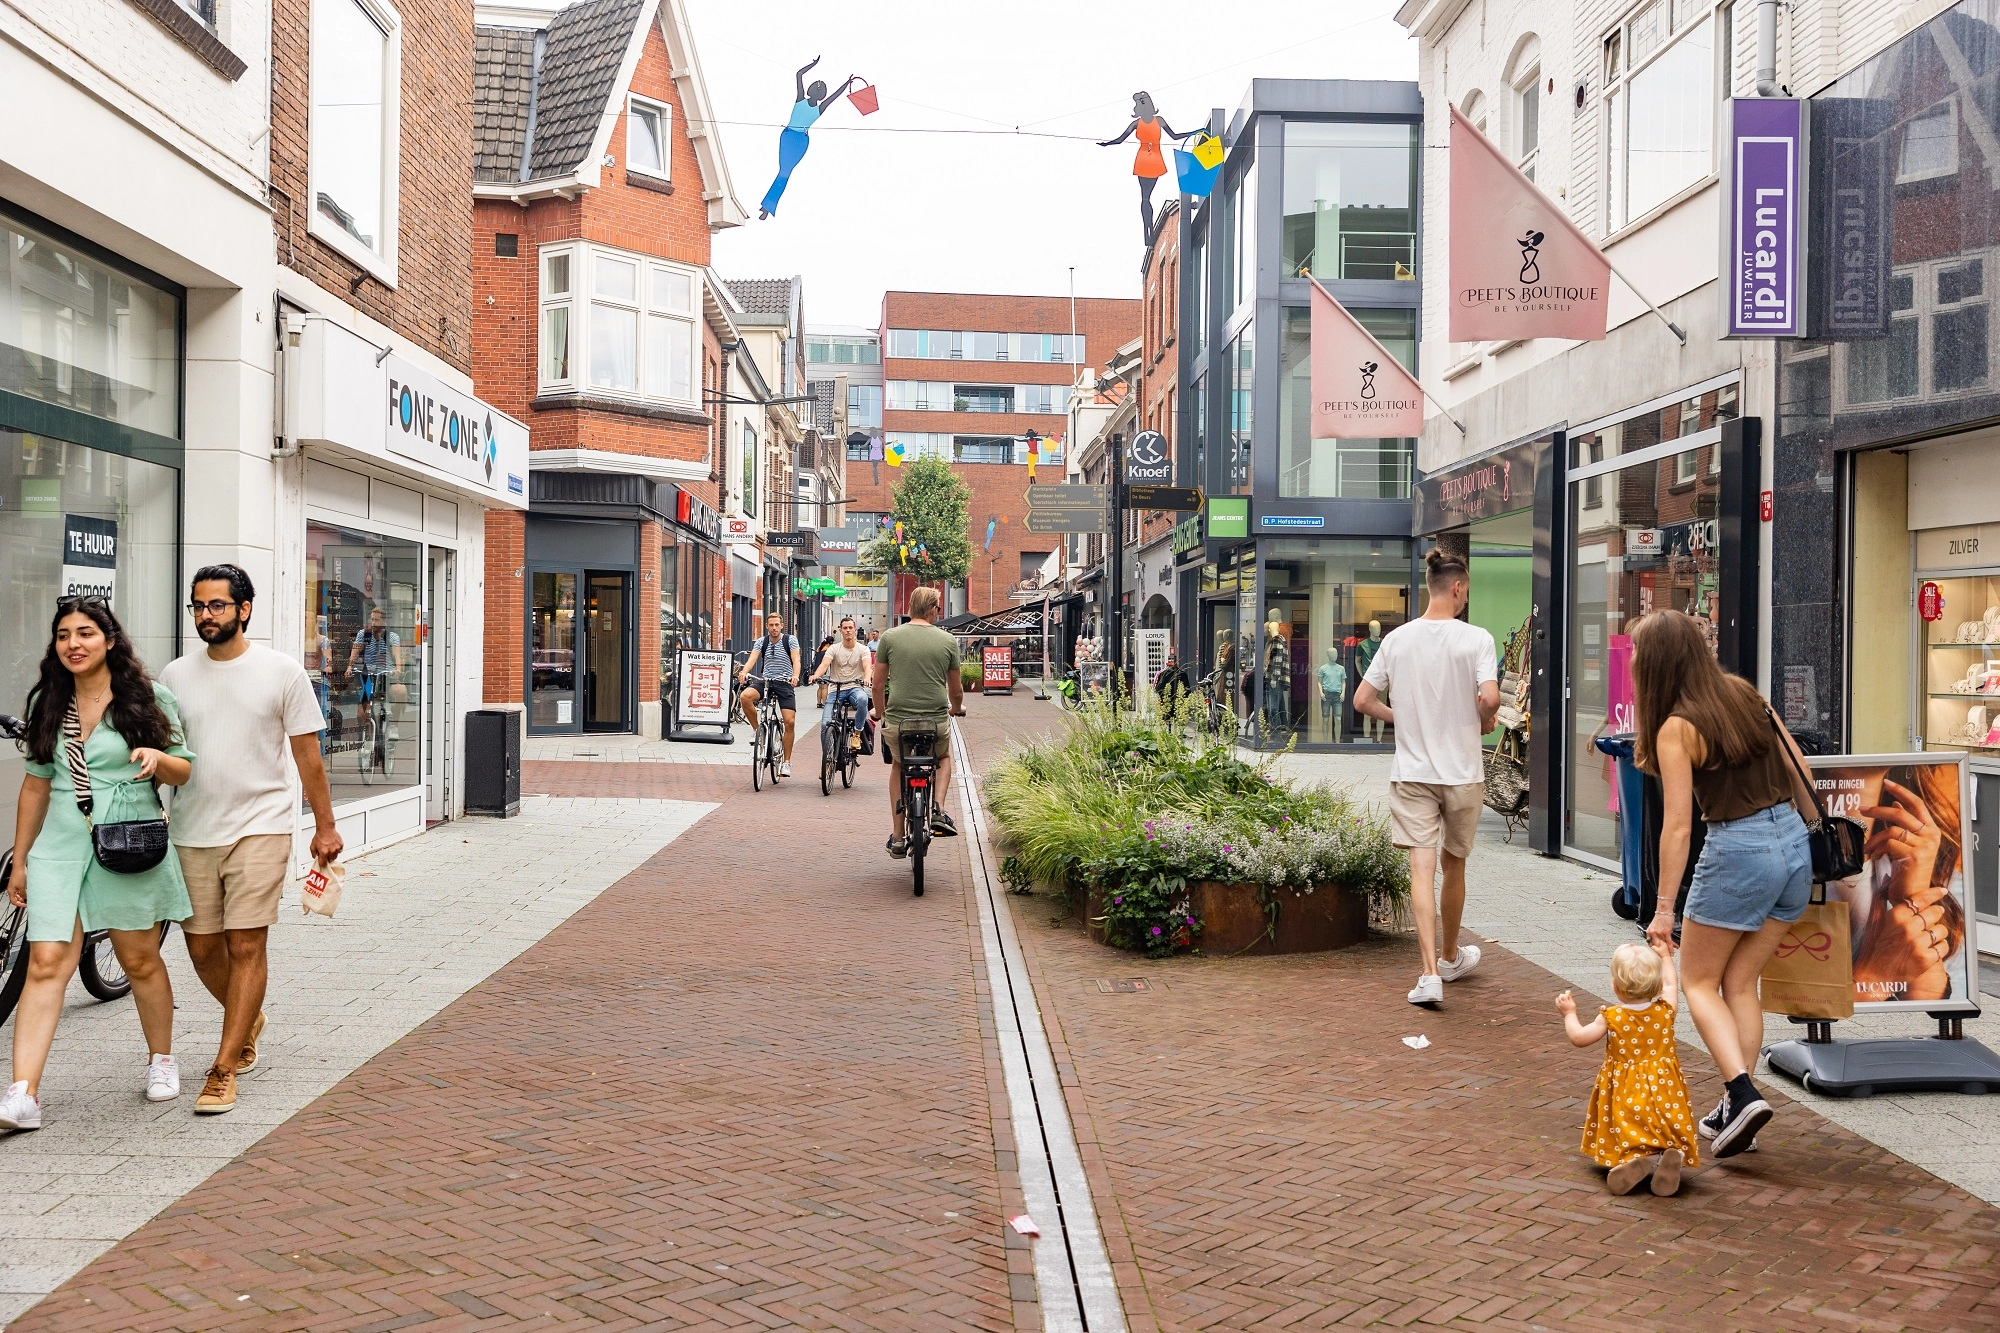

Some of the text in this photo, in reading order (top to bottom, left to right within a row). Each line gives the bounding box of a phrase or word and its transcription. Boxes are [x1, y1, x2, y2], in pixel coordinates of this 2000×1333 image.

[1754, 188, 1784, 320] Lucardi
[1744, 251, 1753, 320] JUWELIER
[1460, 286, 1598, 304] PEET'S BOUTIQUE
[1516, 304, 1572, 312] YOURSELF
[1320, 400, 1418, 412] PEET'S BOUTIQUE
[390, 378, 478, 462] FONE ZONE
[1128, 465, 1170, 478] Knoef
[1463, 464, 1497, 500] BOUTIQUE
[70, 530, 114, 556] TE HUUR
[1949, 538, 1979, 554] ZILVER
[1925, 586, 1935, 596] SALE
[985, 652, 1010, 661] SALE
[985, 672, 1010, 680] SALE
[1838, 779, 1864, 789] RINGEN
[307, 873, 324, 889] AM
[304, 886, 322, 898] AZINE
[1856, 981, 1907, 993] LUCARDI
